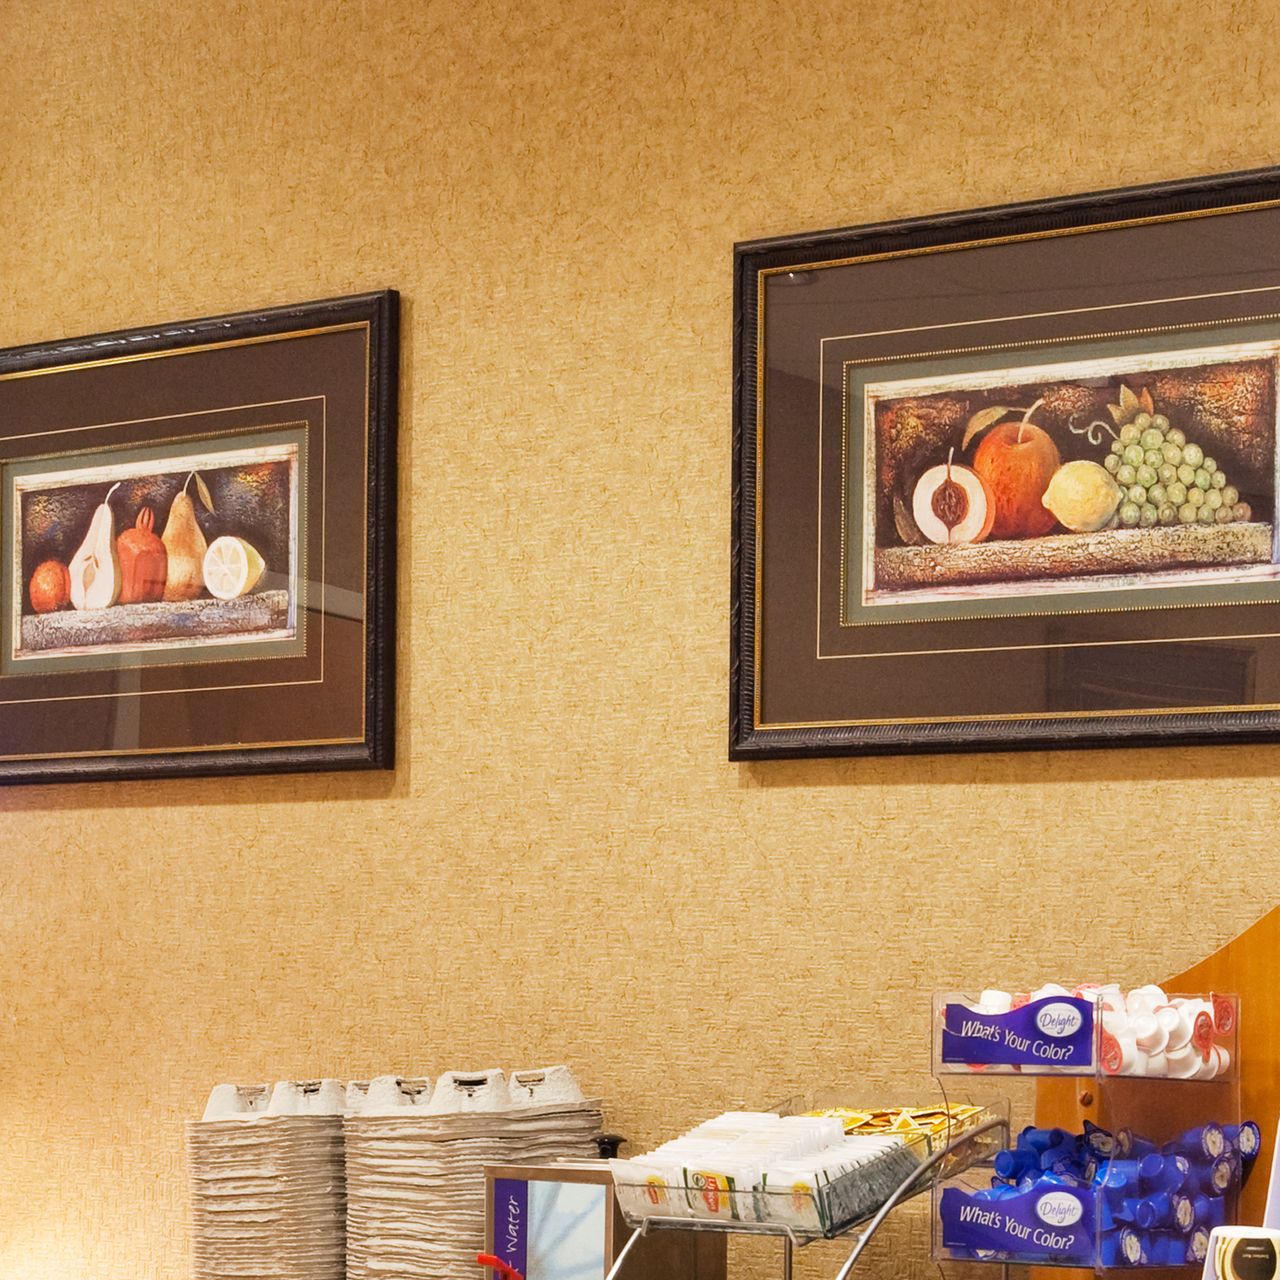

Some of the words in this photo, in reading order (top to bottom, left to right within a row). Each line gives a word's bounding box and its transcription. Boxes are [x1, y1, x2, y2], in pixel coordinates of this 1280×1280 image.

[960, 1020, 1001, 1043] What's
[1004, 1028, 1031, 1052] Your
[1032, 1038, 1074, 1061] Color?
[1040, 1012, 1076, 1035] Delight
[505, 1194, 520, 1253] Water
[959, 1205, 1001, 1228] What's
[1005, 1215, 1032, 1240] Your
[1032, 1228, 1075, 1250] Color?
[1040, 1201, 1076, 1224] Delight
